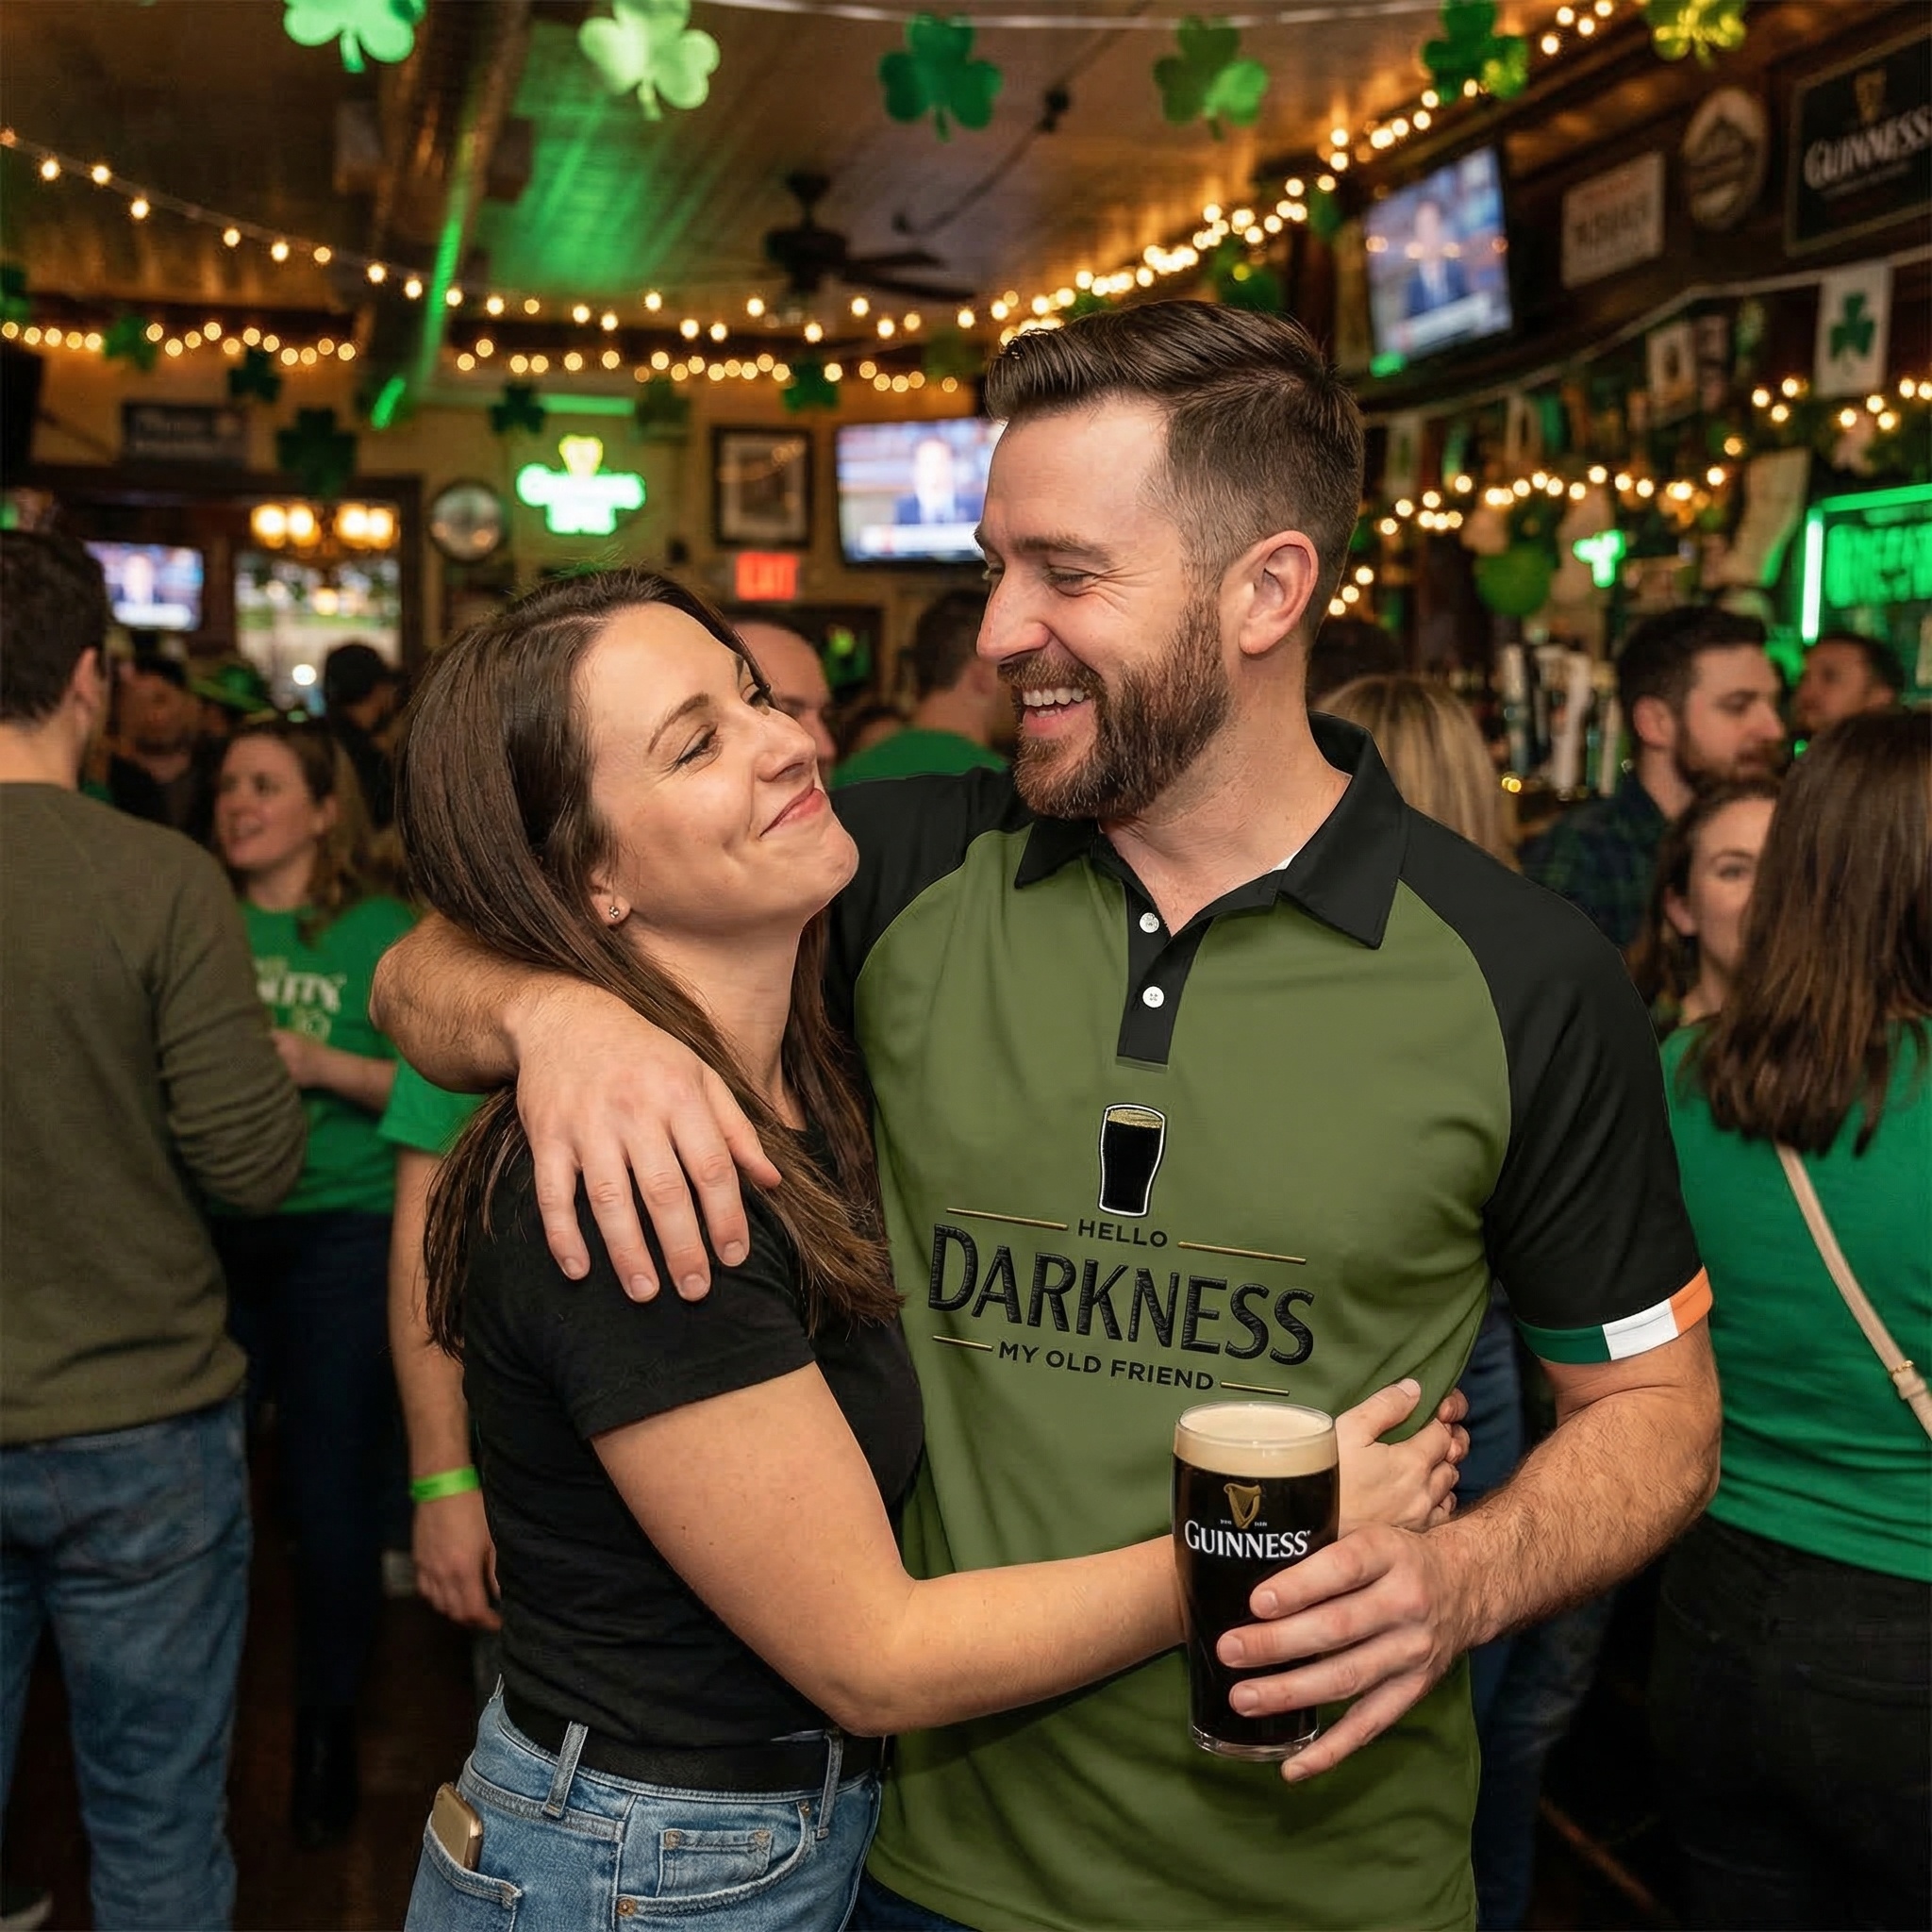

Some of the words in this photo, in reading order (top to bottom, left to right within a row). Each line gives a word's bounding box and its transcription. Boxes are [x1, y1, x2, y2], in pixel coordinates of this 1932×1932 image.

[1077, 1219, 1168, 1248] HELLO
[928, 1224, 1315, 1367] DARKNESS
[999, 1341, 1040, 1364] MY
[1045, 1350, 1102, 1374] OLD
[1109, 1358, 1214, 1391] FRIEND
[1184, 1520, 1308, 1558] GUINNESS
